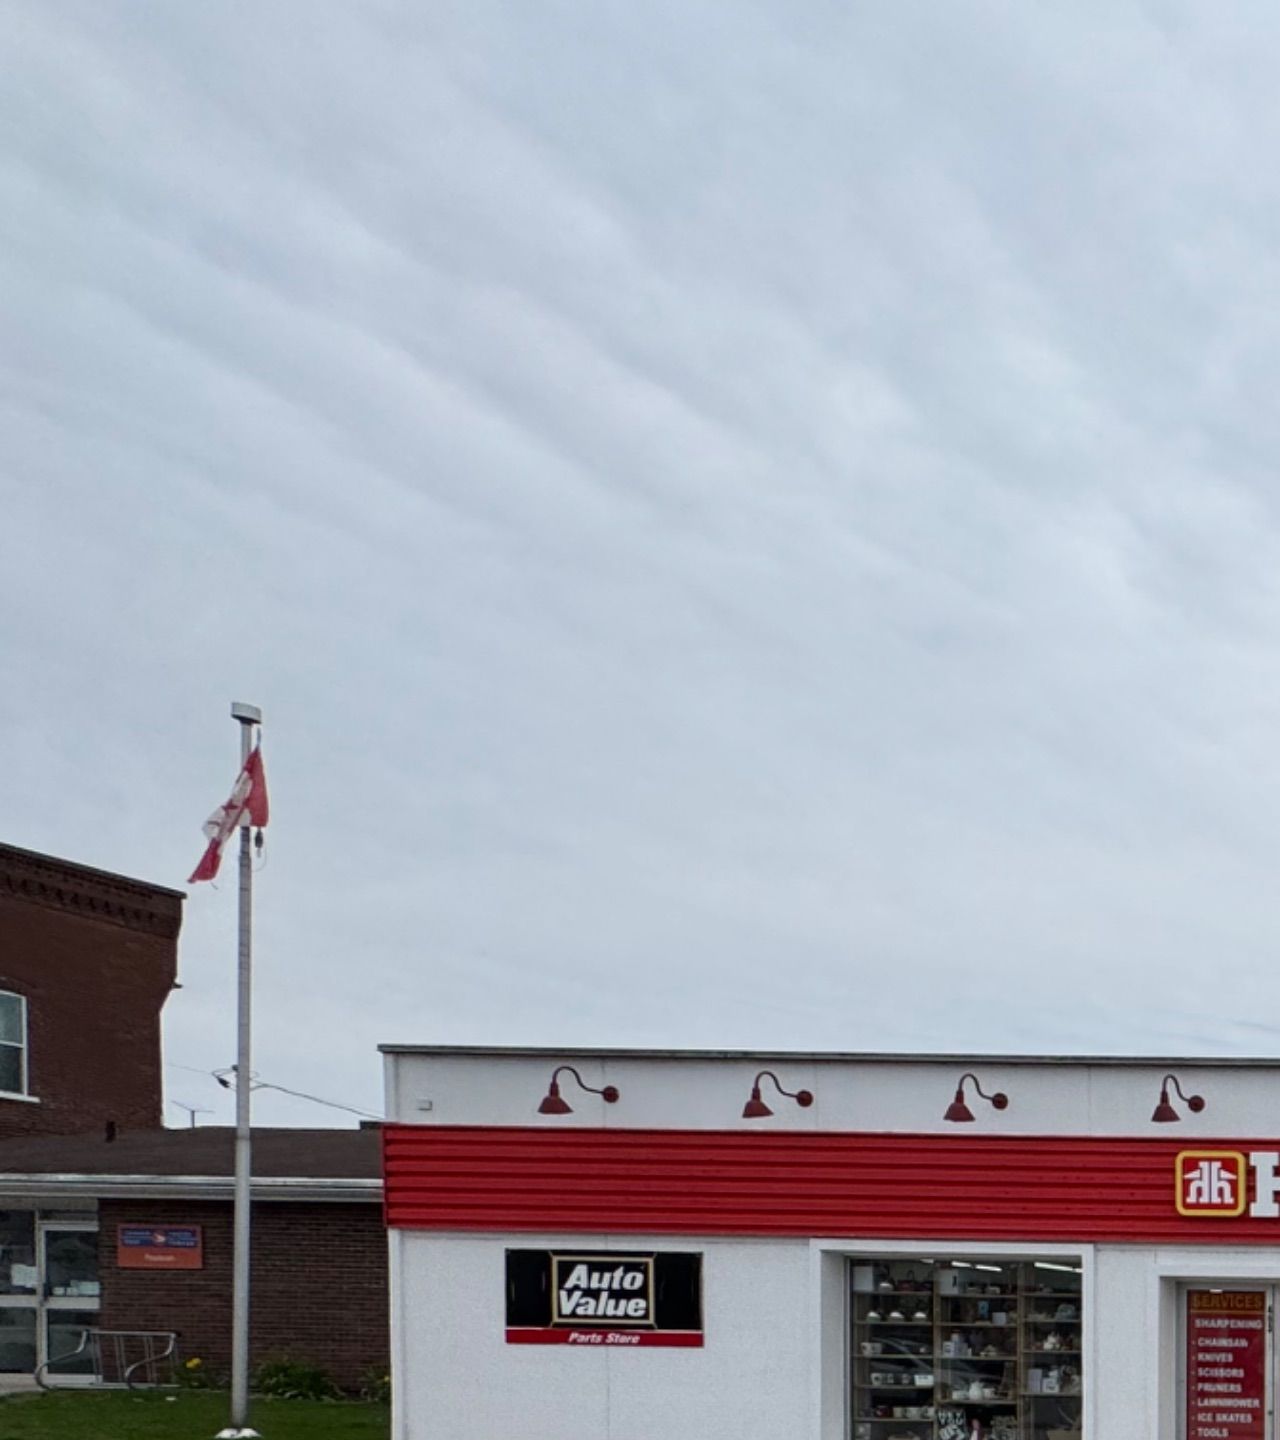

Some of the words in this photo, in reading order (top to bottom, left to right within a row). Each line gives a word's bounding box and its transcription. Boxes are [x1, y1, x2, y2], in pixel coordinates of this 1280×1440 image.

[563, 1263, 645, 1291] Auto
[558, 1289, 647, 1318] Value
[1193, 1295, 1263, 1309] SERVICES
[1194, 1318, 1263, 1330] SHARPENING
[568, 1331, 602, 1344] Parts
[605, 1332, 640, 1345] Store
[1197, 1352, 1233, 1363] KNIVES
[1197, 1367, 1245, 1379] SCISSORS
[1197, 1412, 1213, 1423] ICE
[1215, 1413, 1253, 1424] SKATES
[1197, 1428, 1229, 1438] TOOLS
